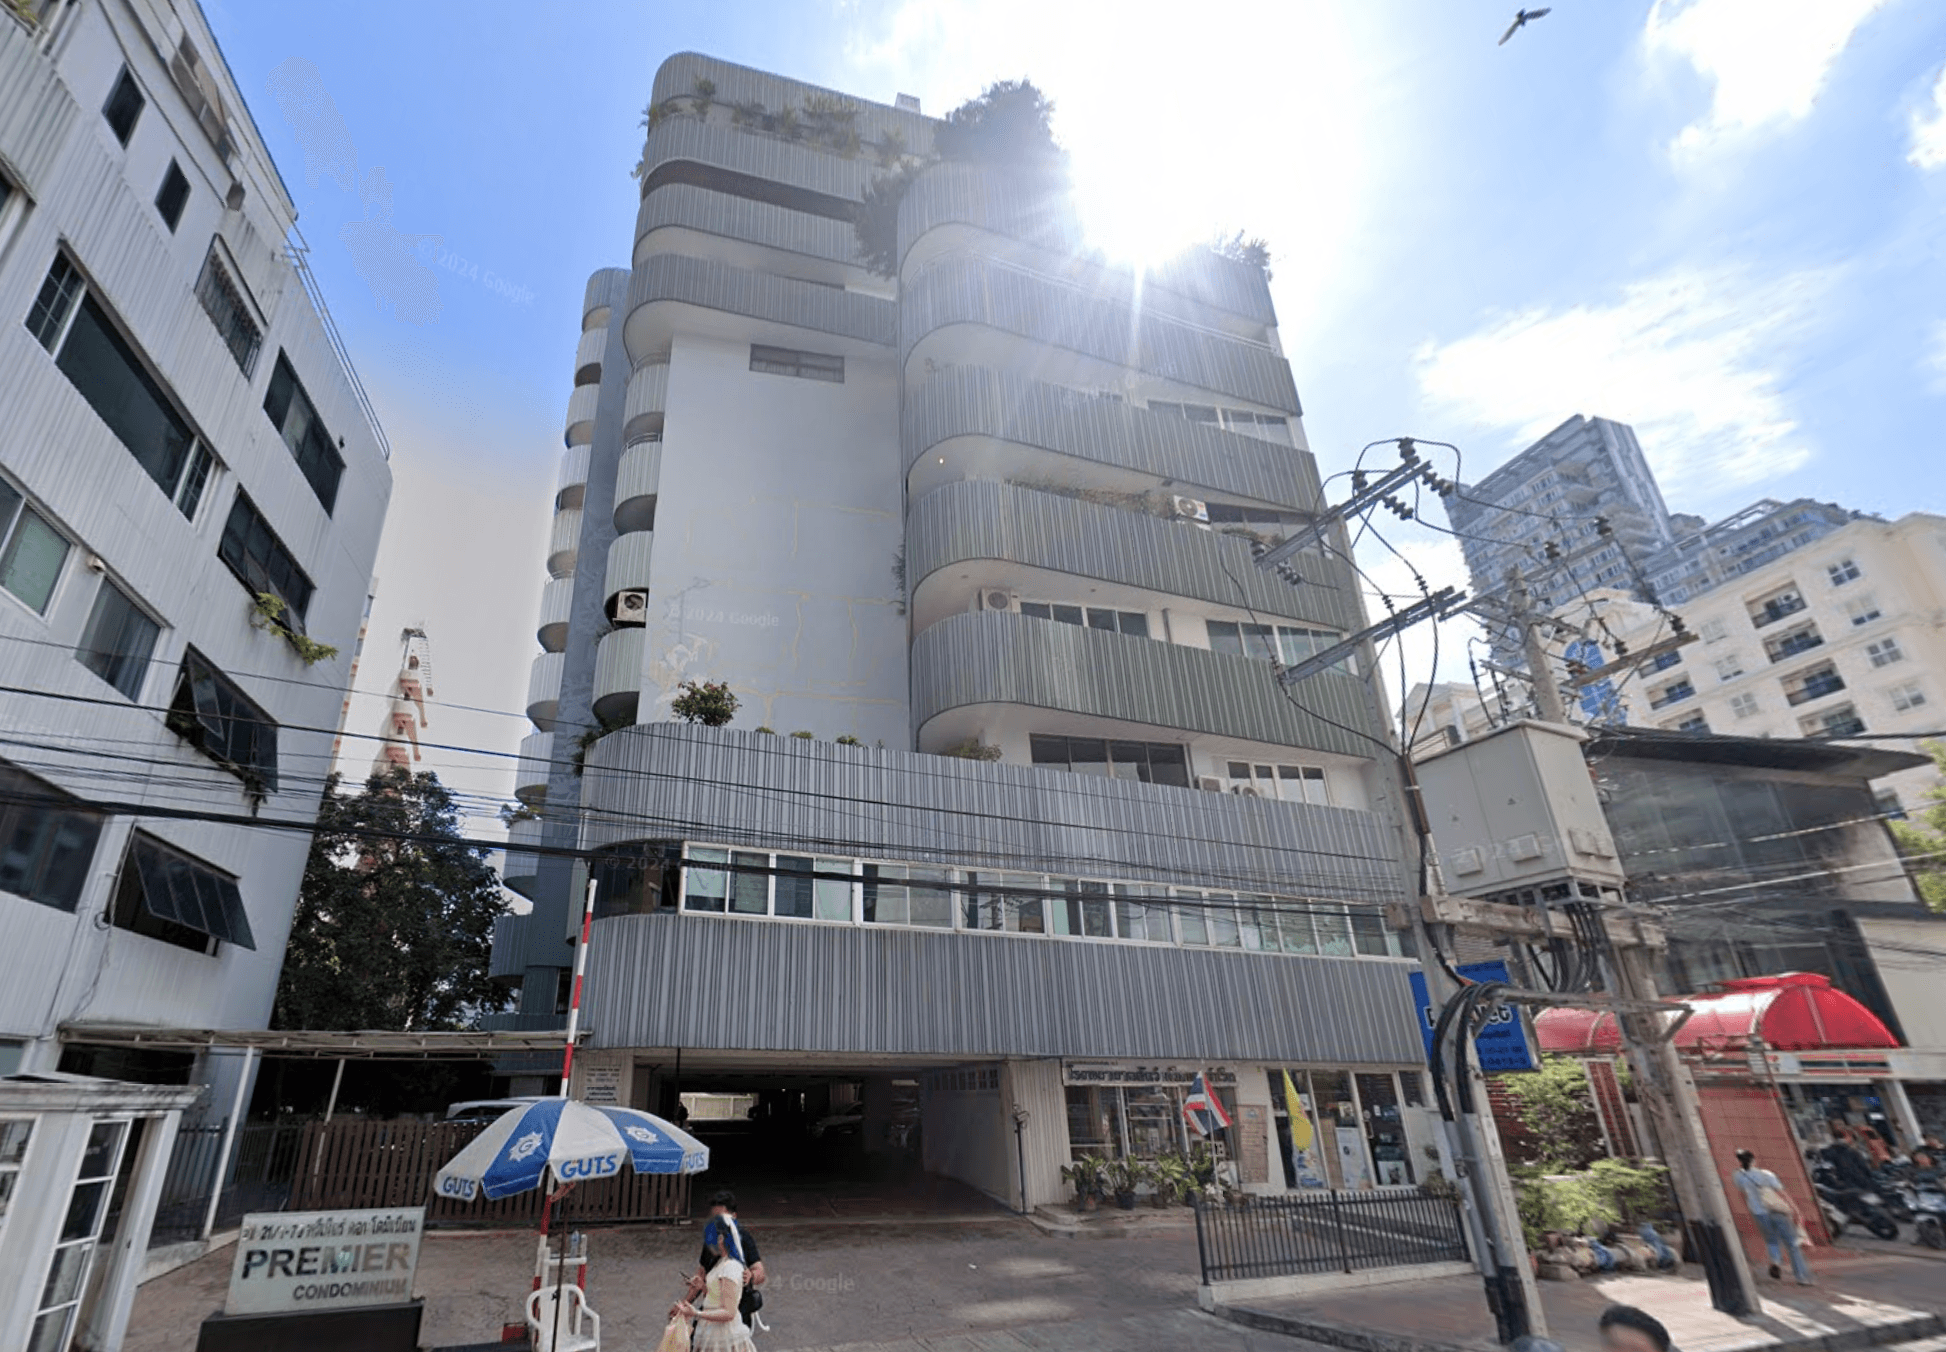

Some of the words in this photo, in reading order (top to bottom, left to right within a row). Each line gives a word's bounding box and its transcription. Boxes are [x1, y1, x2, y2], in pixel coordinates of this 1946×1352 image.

[519, 1139, 534, 1153] G
[560, 1155, 617, 1178] GUTS
[684, 1150, 705, 1169] GUTS
[442, 1176, 476, 1198] GUTS
[241, 1242, 410, 1279] PREMIER
[293, 1279, 408, 1301] CONDOMINIUM
